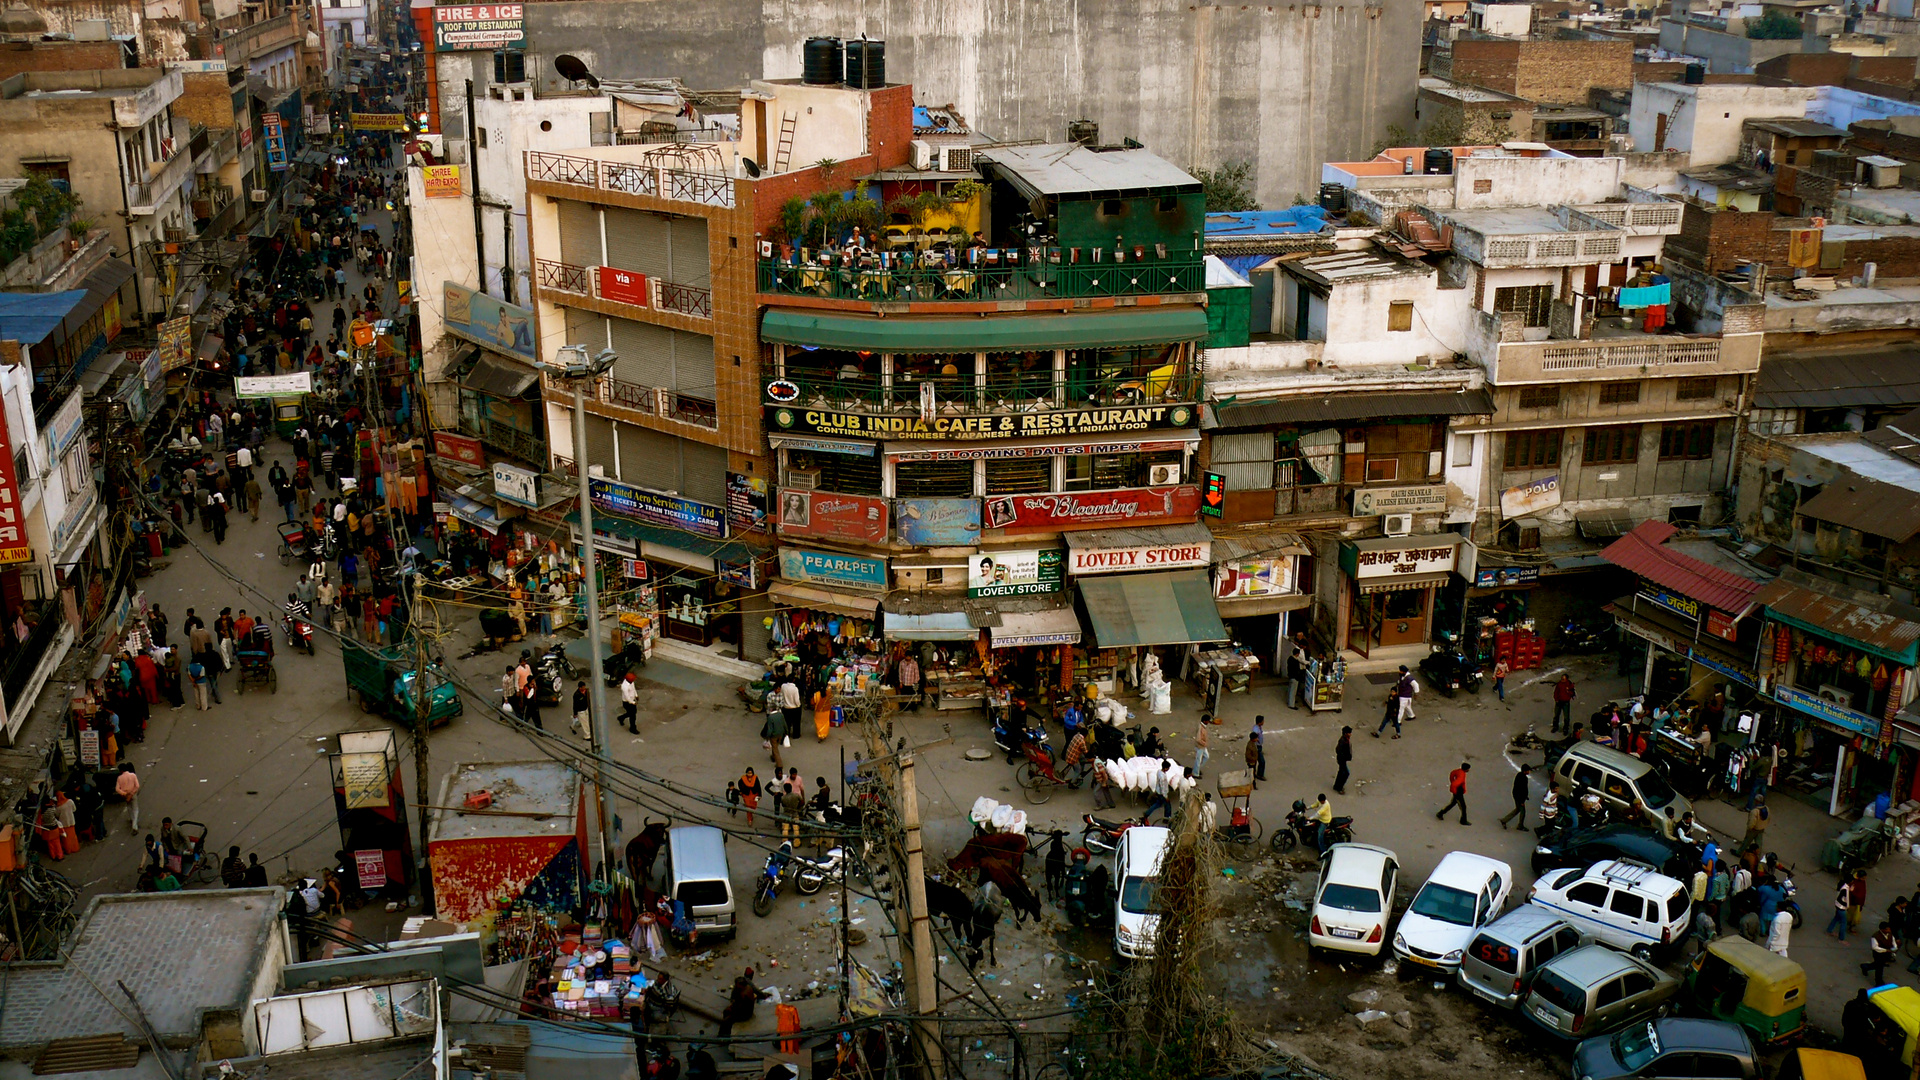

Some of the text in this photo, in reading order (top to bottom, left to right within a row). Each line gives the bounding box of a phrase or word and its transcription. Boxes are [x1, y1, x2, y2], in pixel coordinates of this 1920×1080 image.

[437, 6, 522, 20] FIRE & ICE
[444, 20, 522, 31] ROOF TOP RESTAURANT
[431, 168, 451, 177] SHREE
[443, 178, 459, 186] EXPO
[615, 273, 630, 284] via
[771, 386, 794, 395] OPEN
[805, 407, 1166, 432] CLUB INDIA CAFE & RESTAURANT
[816, 425, 888, 438] CONTINENTAL
[955, 431, 1011, 439] JAPANESE
[1020, 427, 1066, 437] TIBETAN
[1080, 424, 1116, 433] INDIAN
[1119, 422, 1148, 430] FOOD
[937, 449, 1025, 460] BLOOMING
[1031, 446, 1084, 457] DALES
[1090, 443, 1141, 453] IMPEX
[1525, 481, 1556, 497] POLO
[609, 485, 632, 498] United
[633, 493, 651, 504] Aero
[652, 495, 682, 511] Services
[684, 503, 699, 515] Pvt.
[701, 506, 715, 518] Ltd
[1041, 495, 1139, 517] Blooming
[613, 497, 637, 508] TICKETS
[645, 504, 663, 514] TRAIN
[664, 509, 689, 520] TICKETS
[697, 517, 719, 527] CARGO
[11, 548, 28, 559] INN
[1076, 551, 1139, 568] LOVELY
[1146, 547, 1201, 563] STORE
[806, 556, 876, 574] PEARLPET
[977, 583, 1052, 597] LOVELY STORE
[1666, 595, 1698, 616] जलेबी
[992, 637, 1019, 645] LOVELY
[1793, 694, 1862, 726] Banaras Handicraft
